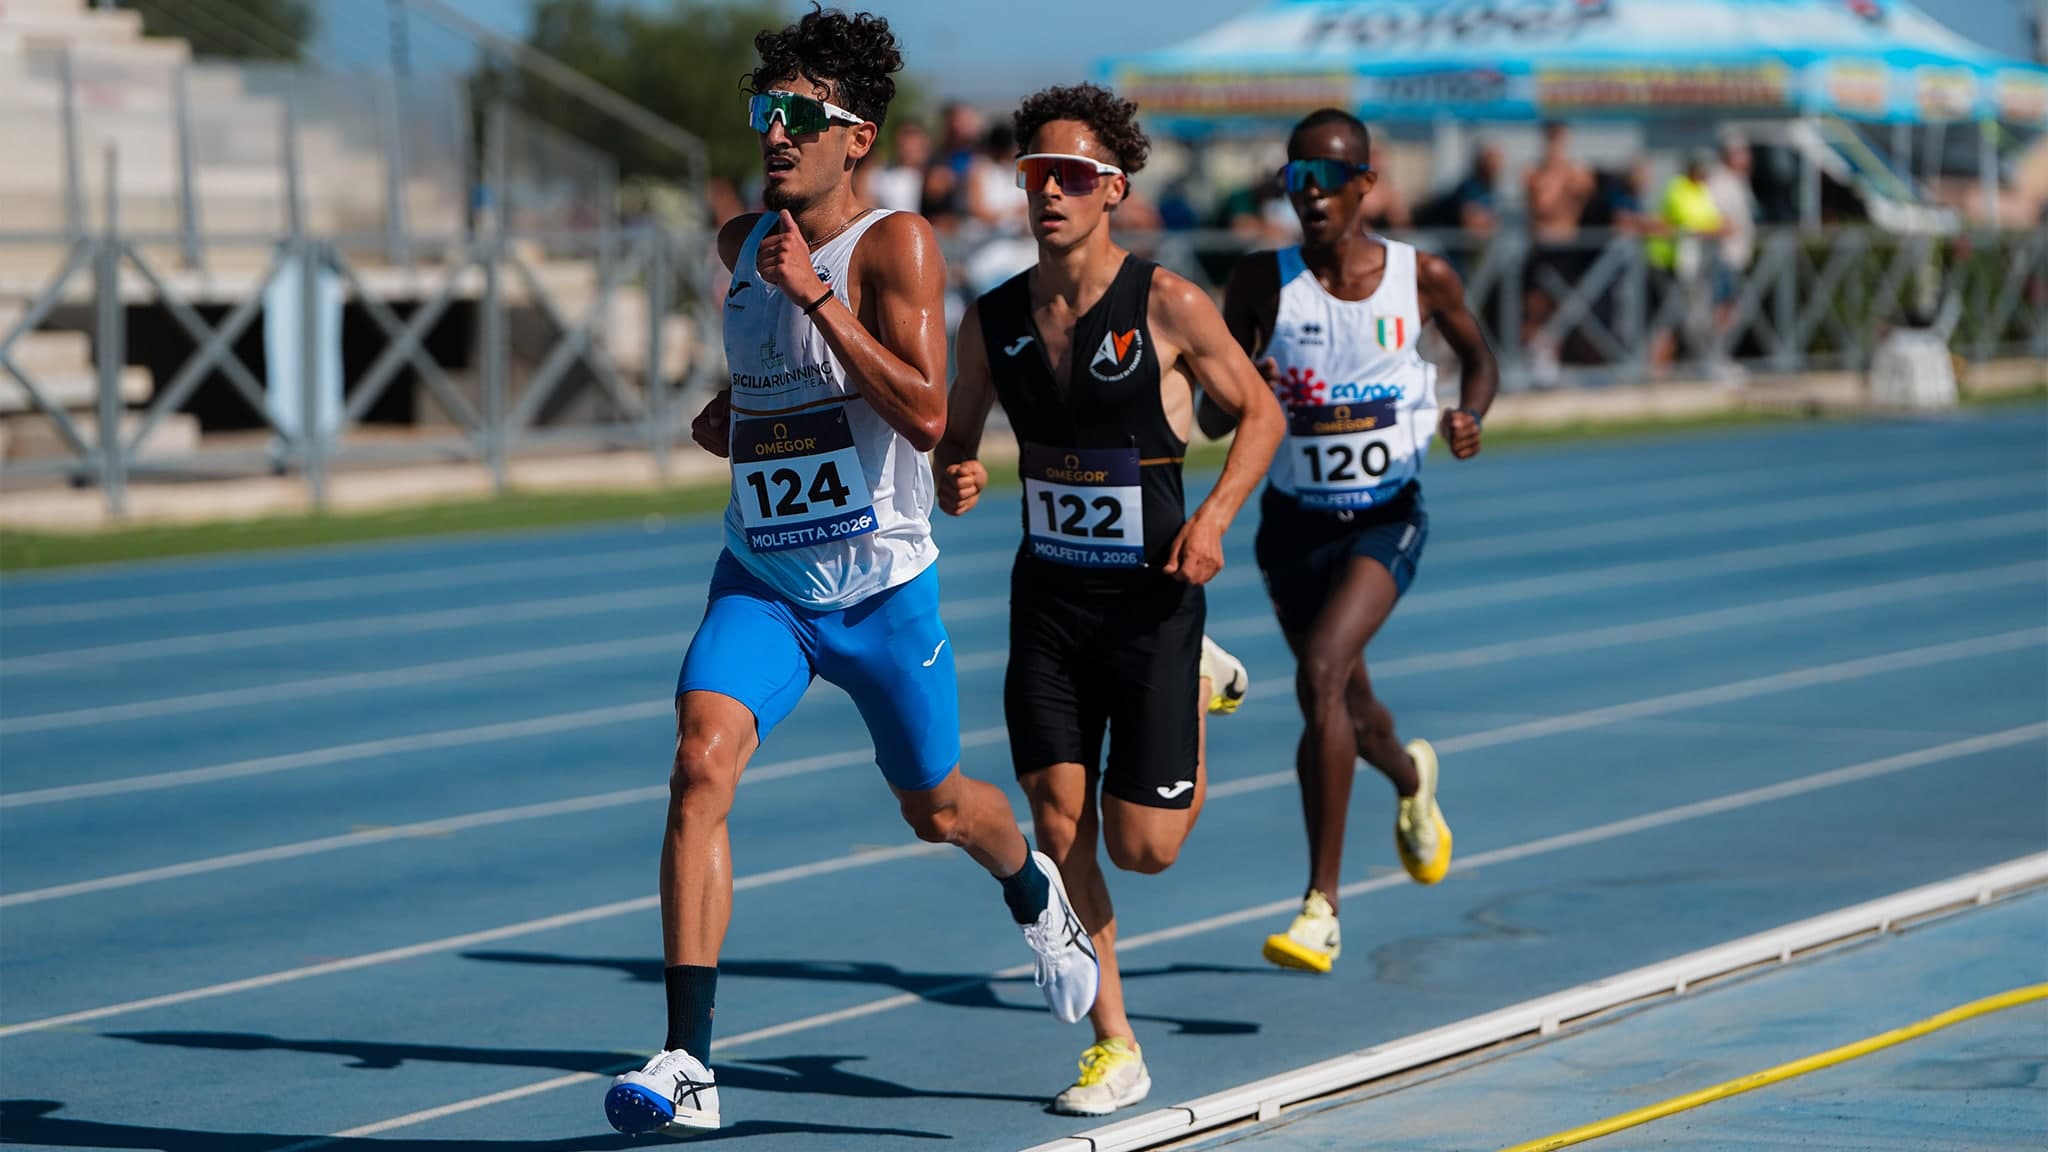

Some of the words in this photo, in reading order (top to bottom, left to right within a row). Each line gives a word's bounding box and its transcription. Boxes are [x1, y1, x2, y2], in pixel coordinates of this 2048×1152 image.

[732, 361, 832, 389] SICILIARUNNING
[804, 375, 835, 389] TEAM
[755, 438, 816, 456] OMEGOR
[1046, 467, 1105, 483] OMEGOR
[1302, 440, 1391, 483] 120
[746, 460, 851, 519] 124
[1038, 490, 1125, 538] 122
[751, 527, 829, 548] MOLFETTA
[829, 515, 870, 537] 2026
[1034, 542, 1100, 563] MOLFETTA
[1101, 551, 1138, 565] 2026
